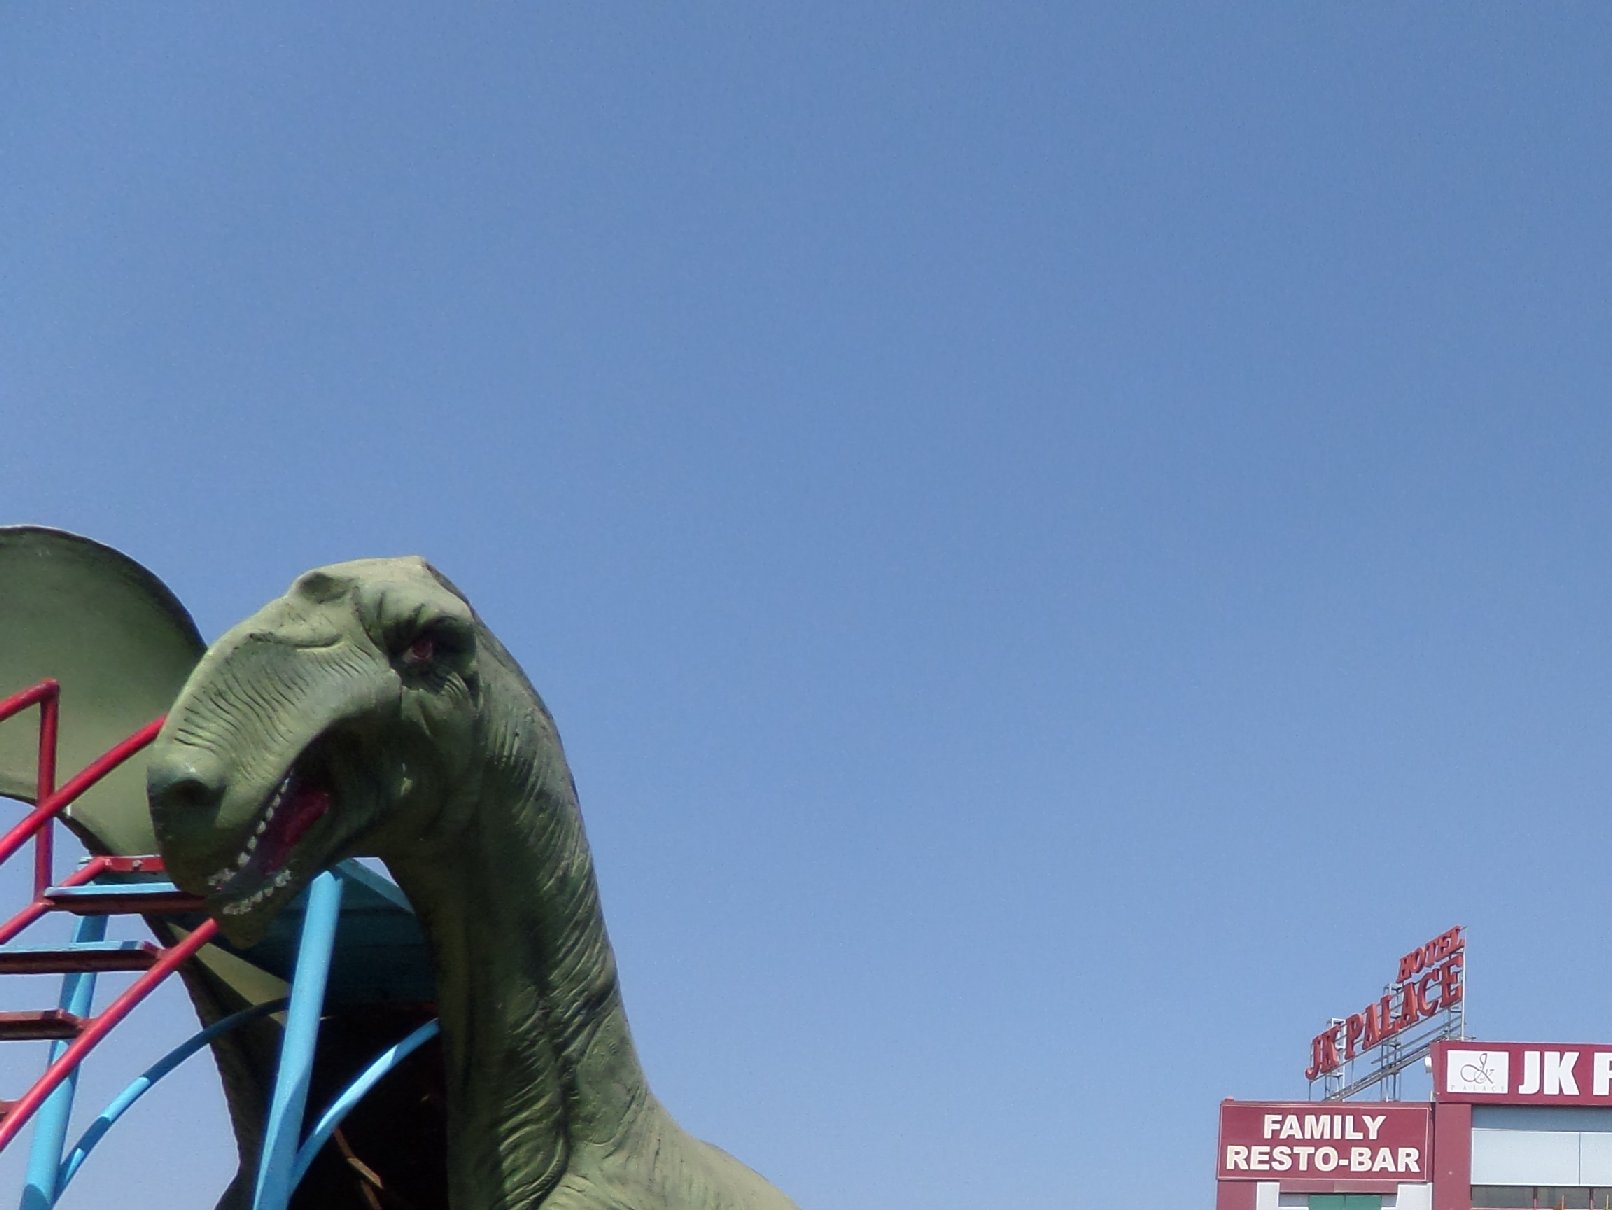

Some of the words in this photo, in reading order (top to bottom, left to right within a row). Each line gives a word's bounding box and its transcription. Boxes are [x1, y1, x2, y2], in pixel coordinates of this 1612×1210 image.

[1397, 925, 1465, 983] HOTEL
[1305, 1023, 1342, 1080] JK
[1344, 953, 1464, 1061] PALACE
[1518, 1050, 1580, 1096] JK
[1263, 1114, 1387, 1140] FAMILY
[1226, 1145, 1421, 1173] RESTO-BAR
